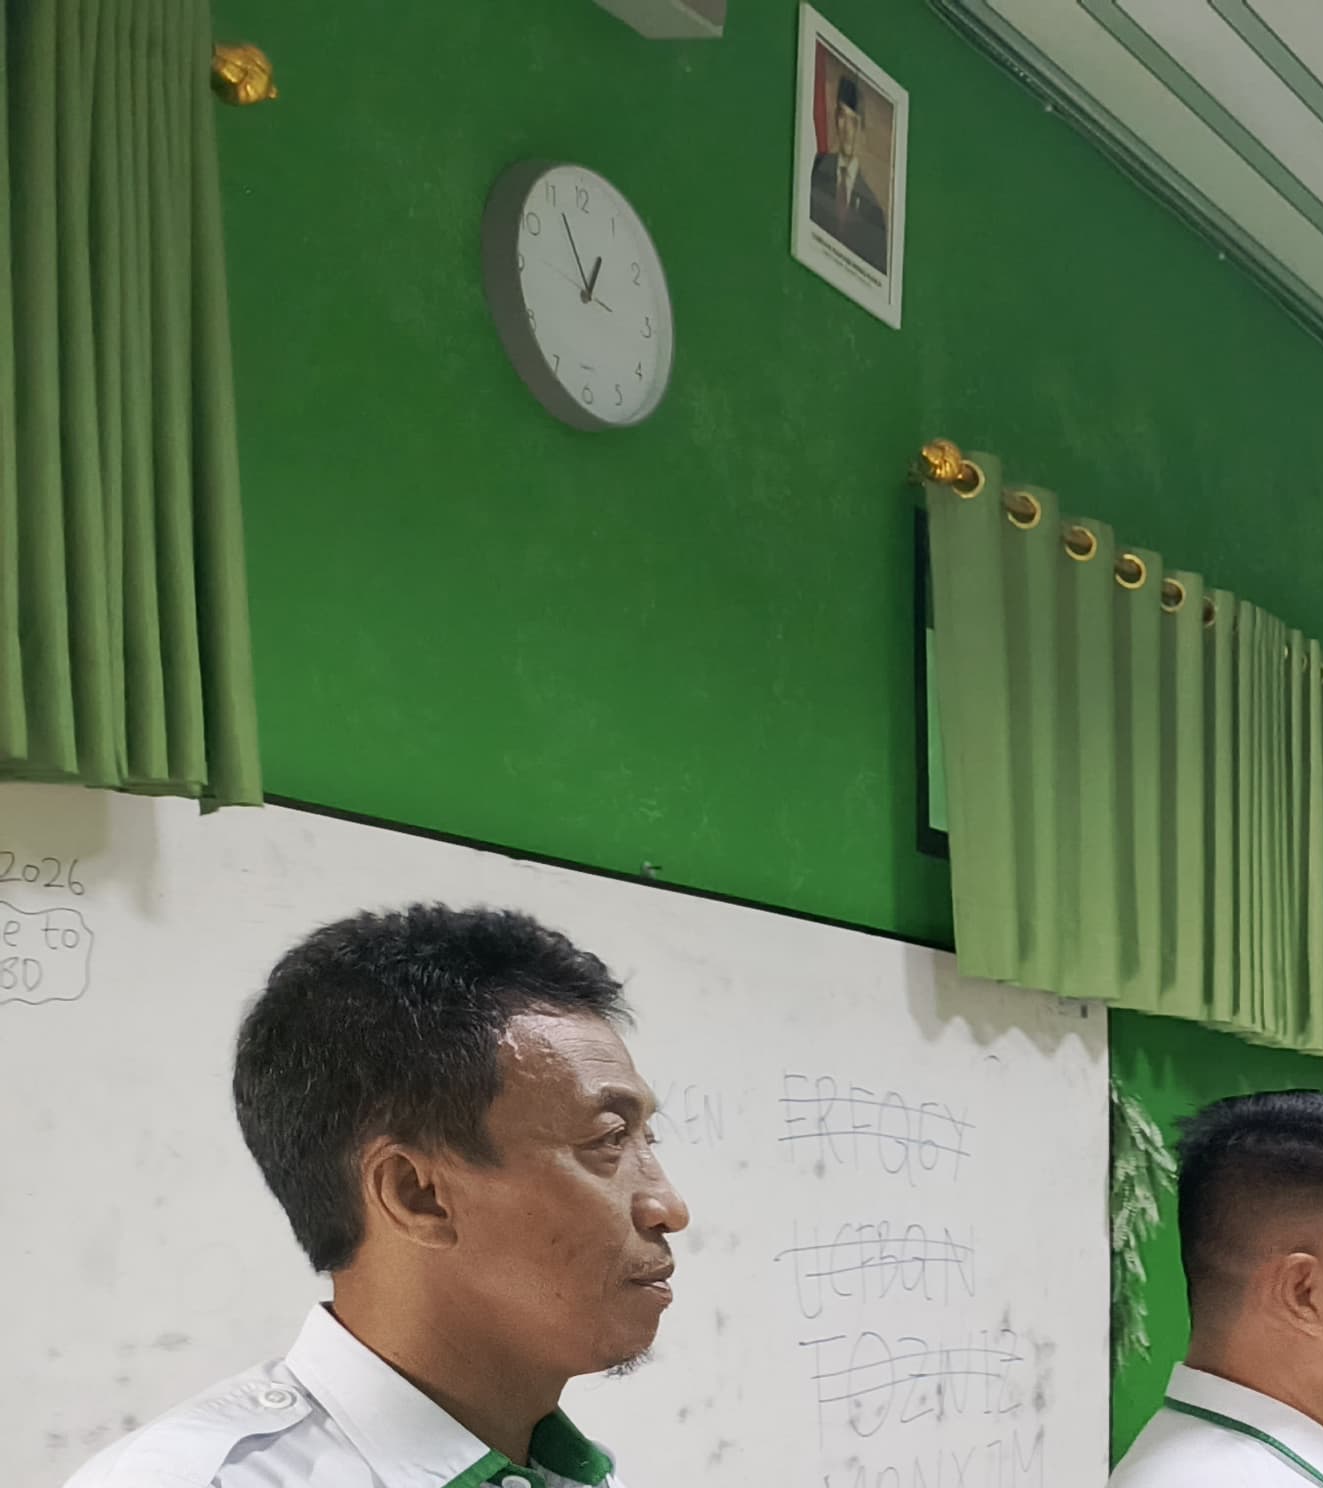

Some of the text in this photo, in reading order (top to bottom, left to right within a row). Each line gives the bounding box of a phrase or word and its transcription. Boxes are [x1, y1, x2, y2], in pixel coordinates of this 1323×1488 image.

[575, 185, 590, 214] 12
[631, 262, 641, 286] 2
[639, 316, 652, 339] 3
[40, 913, 80, 951] to
